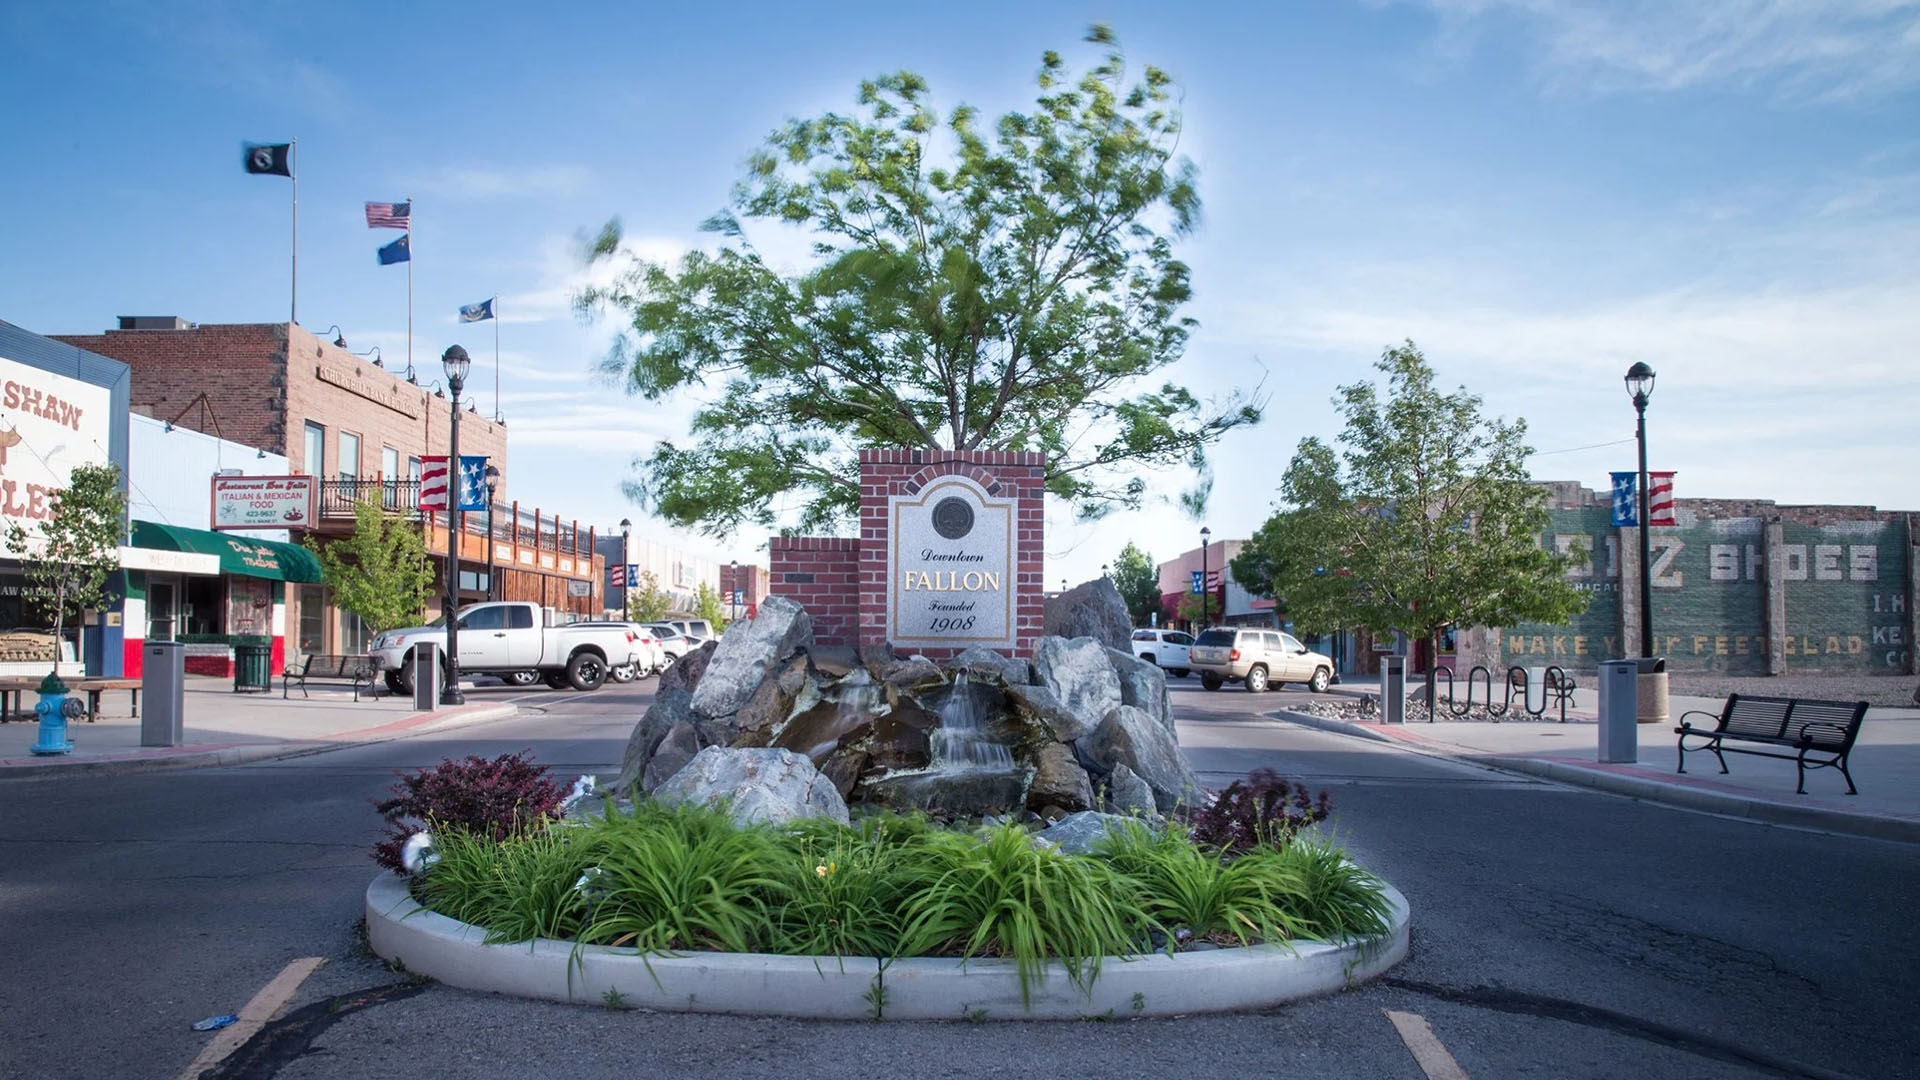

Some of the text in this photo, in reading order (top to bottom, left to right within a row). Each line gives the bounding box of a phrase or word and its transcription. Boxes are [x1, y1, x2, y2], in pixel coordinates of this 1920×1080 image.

[0, 379, 83, 432] SHAW
[221, 493, 254, 501] ITALIAN
[264, 492, 303, 500] MEXICAN
[249, 501, 274, 509] FOOD
[921, 548, 984, 563] Downtown
[904, 570, 1000, 592] FALLON
[928, 600, 976, 612] Founded
[930, 615, 976, 633] 1908
[1872, 626, 1908, 645] KE
[1509, 635, 1589, 655] MAKE
